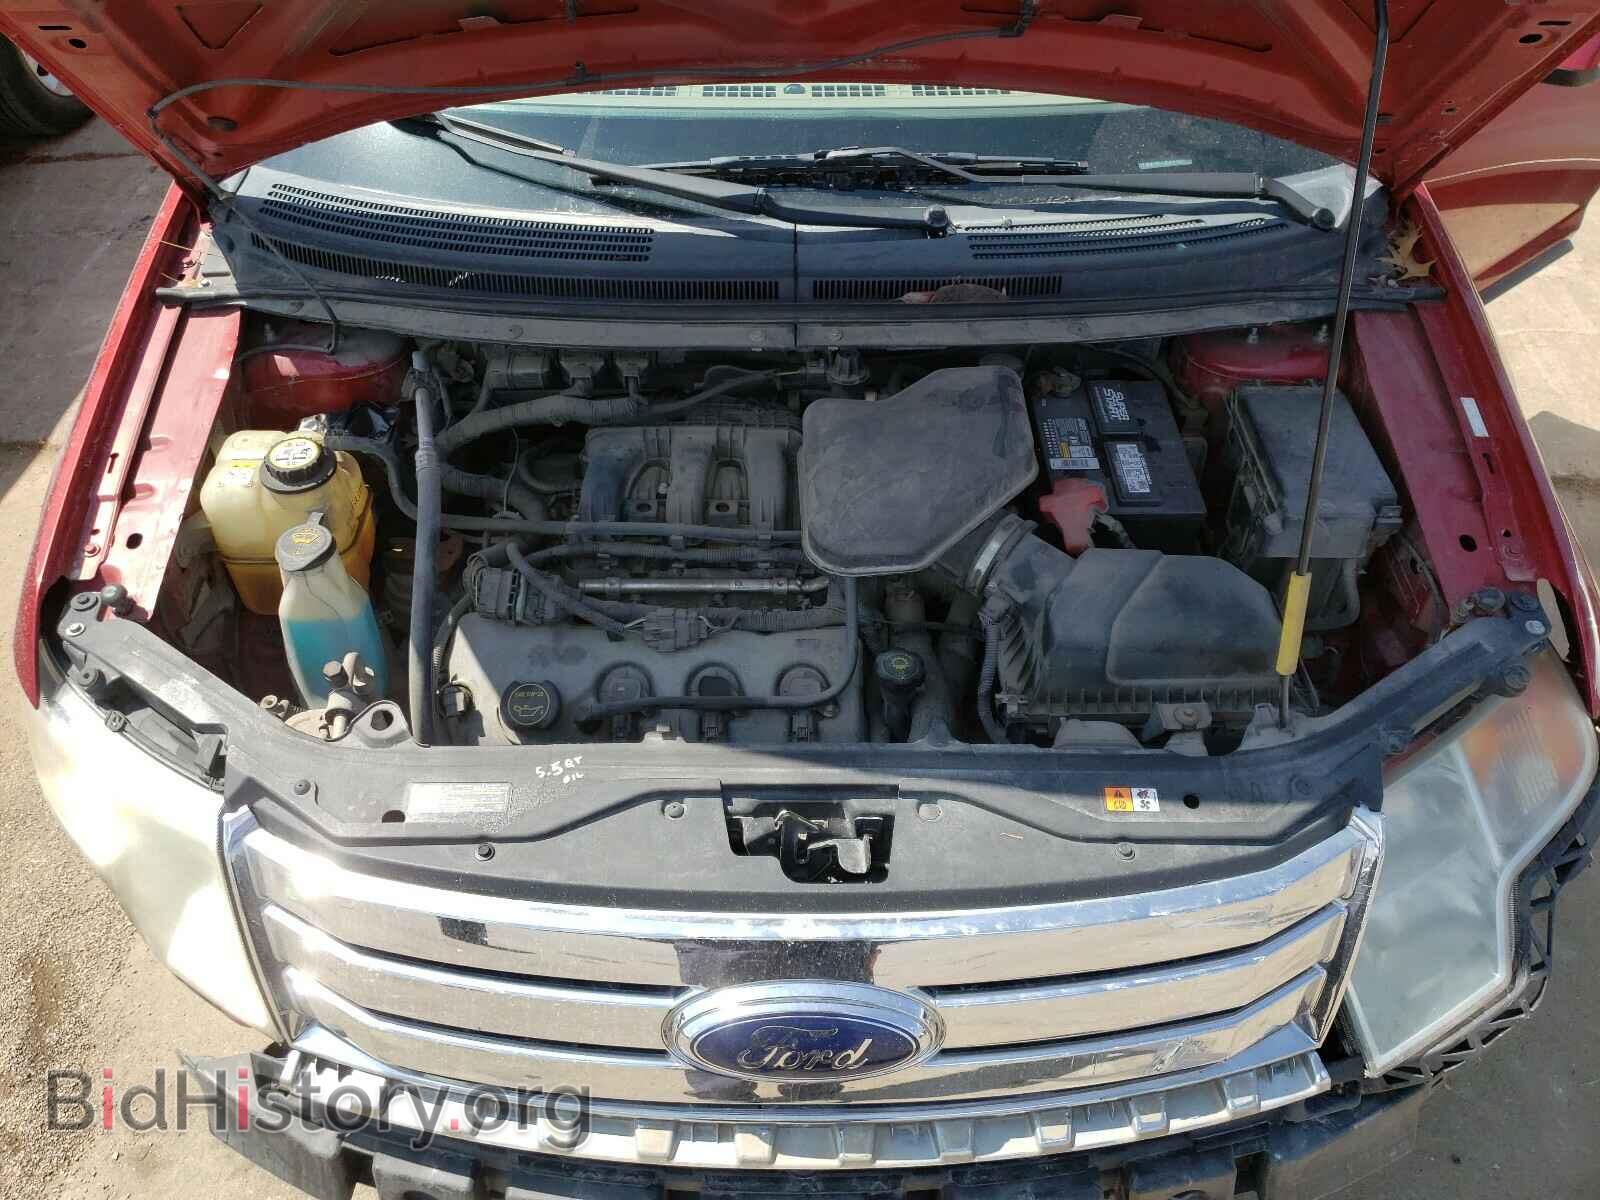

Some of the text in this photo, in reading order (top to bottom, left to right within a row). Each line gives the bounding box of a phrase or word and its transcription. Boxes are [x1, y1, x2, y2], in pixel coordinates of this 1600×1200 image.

[1102, 387, 1121, 419] START
[1113, 390, 1130, 421] SUPER
[562, 772, 585, 784] OIL
[736, 1025, 873, 1070] Ford
